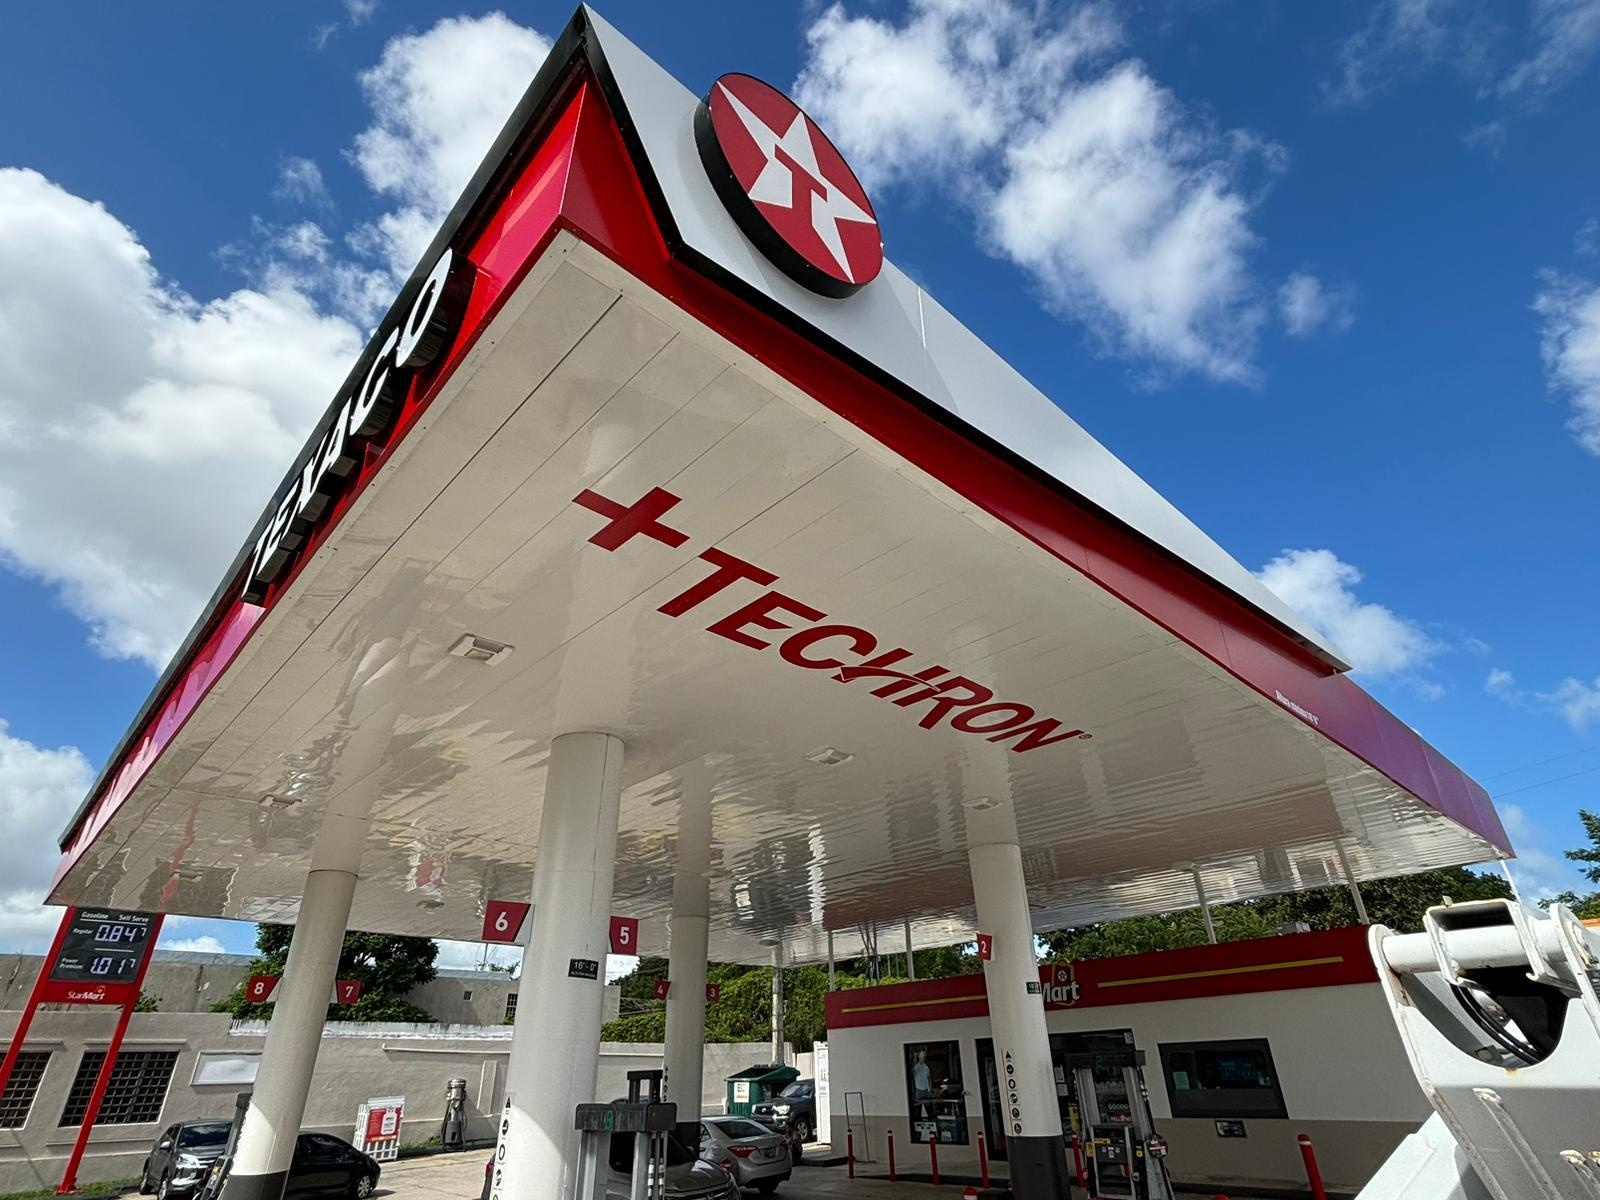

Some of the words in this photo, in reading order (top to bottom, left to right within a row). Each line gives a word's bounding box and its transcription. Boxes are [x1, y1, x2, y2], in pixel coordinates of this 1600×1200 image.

[241, 248, 455, 600] TEXACO
[495, 911, 509, 932] 6
[619, 926, 630, 945] 5
[981, 940, 988, 954] 2
[67, 990, 106, 1000] StarMart
[253, 982, 264, 995] 8
[345, 986, 354, 998] 7
[657, 984, 664, 995] 4
[709, 987, 716, 998] 3
